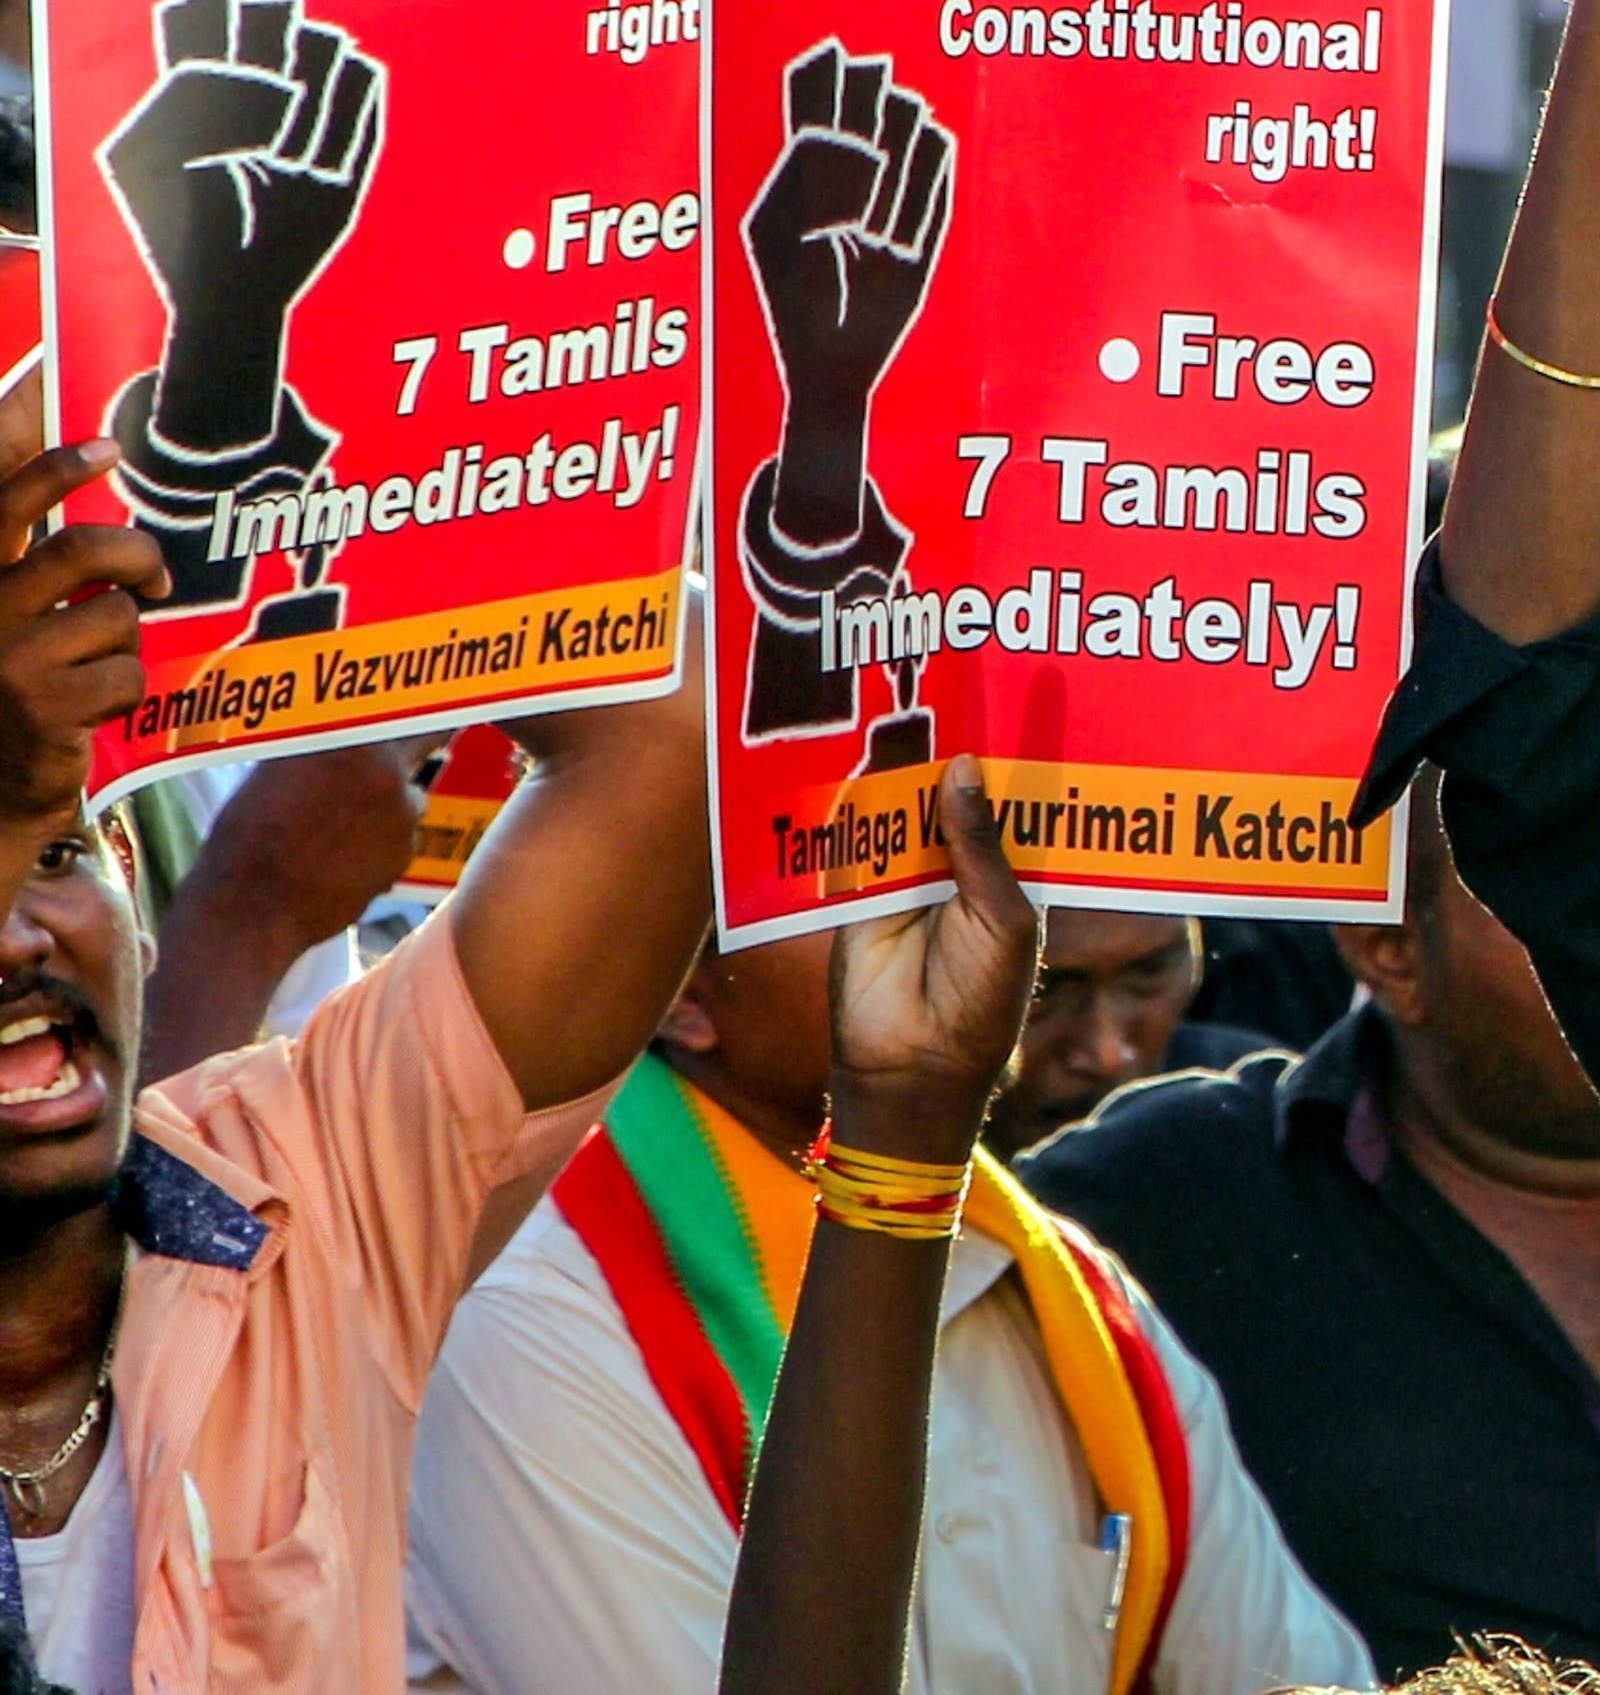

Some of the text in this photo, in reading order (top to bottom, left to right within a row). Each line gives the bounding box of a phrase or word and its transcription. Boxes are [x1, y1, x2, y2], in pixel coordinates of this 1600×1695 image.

[1205, 100, 1378, 184] right!
[546, 191, 700, 273] Free
[393, 297, 688, 417] 7 Tamils
[1157, 310, 1375, 406] Free
[206, 406, 681, 562] Immediately!
[957, 436, 1369, 540] 7 Tamils
[313, 615, 528, 705] Vazvurimai
[538, 593, 670, 666] Katchi
[820, 569, 1361, 690] Immediately!
[773, 802, 907, 879] Tamilaga
